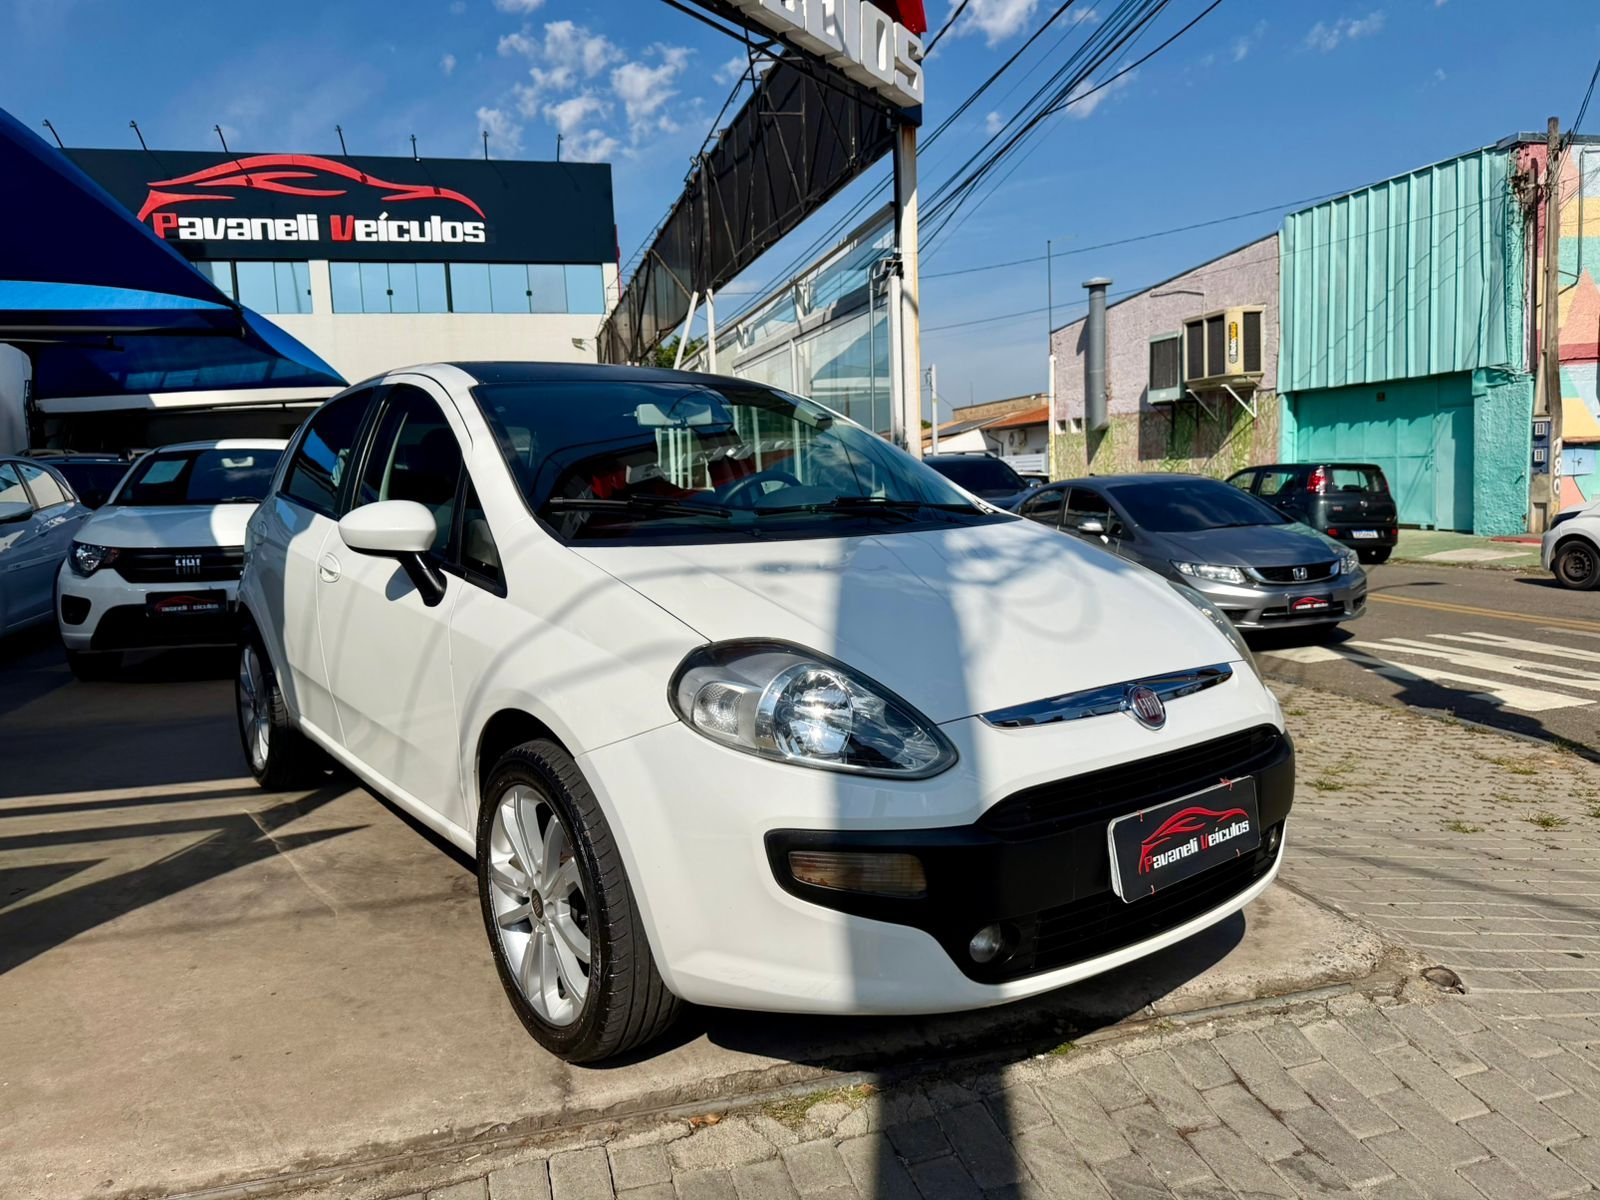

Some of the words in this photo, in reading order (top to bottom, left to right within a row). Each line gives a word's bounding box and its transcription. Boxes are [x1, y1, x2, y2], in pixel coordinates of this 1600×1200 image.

[152, 212, 320, 241] Pavaneli
[329, 210, 487, 243] Veículos
[1144, 836, 1199, 873] Pavaneli
[1200, 819, 1250, 851] Veículos
